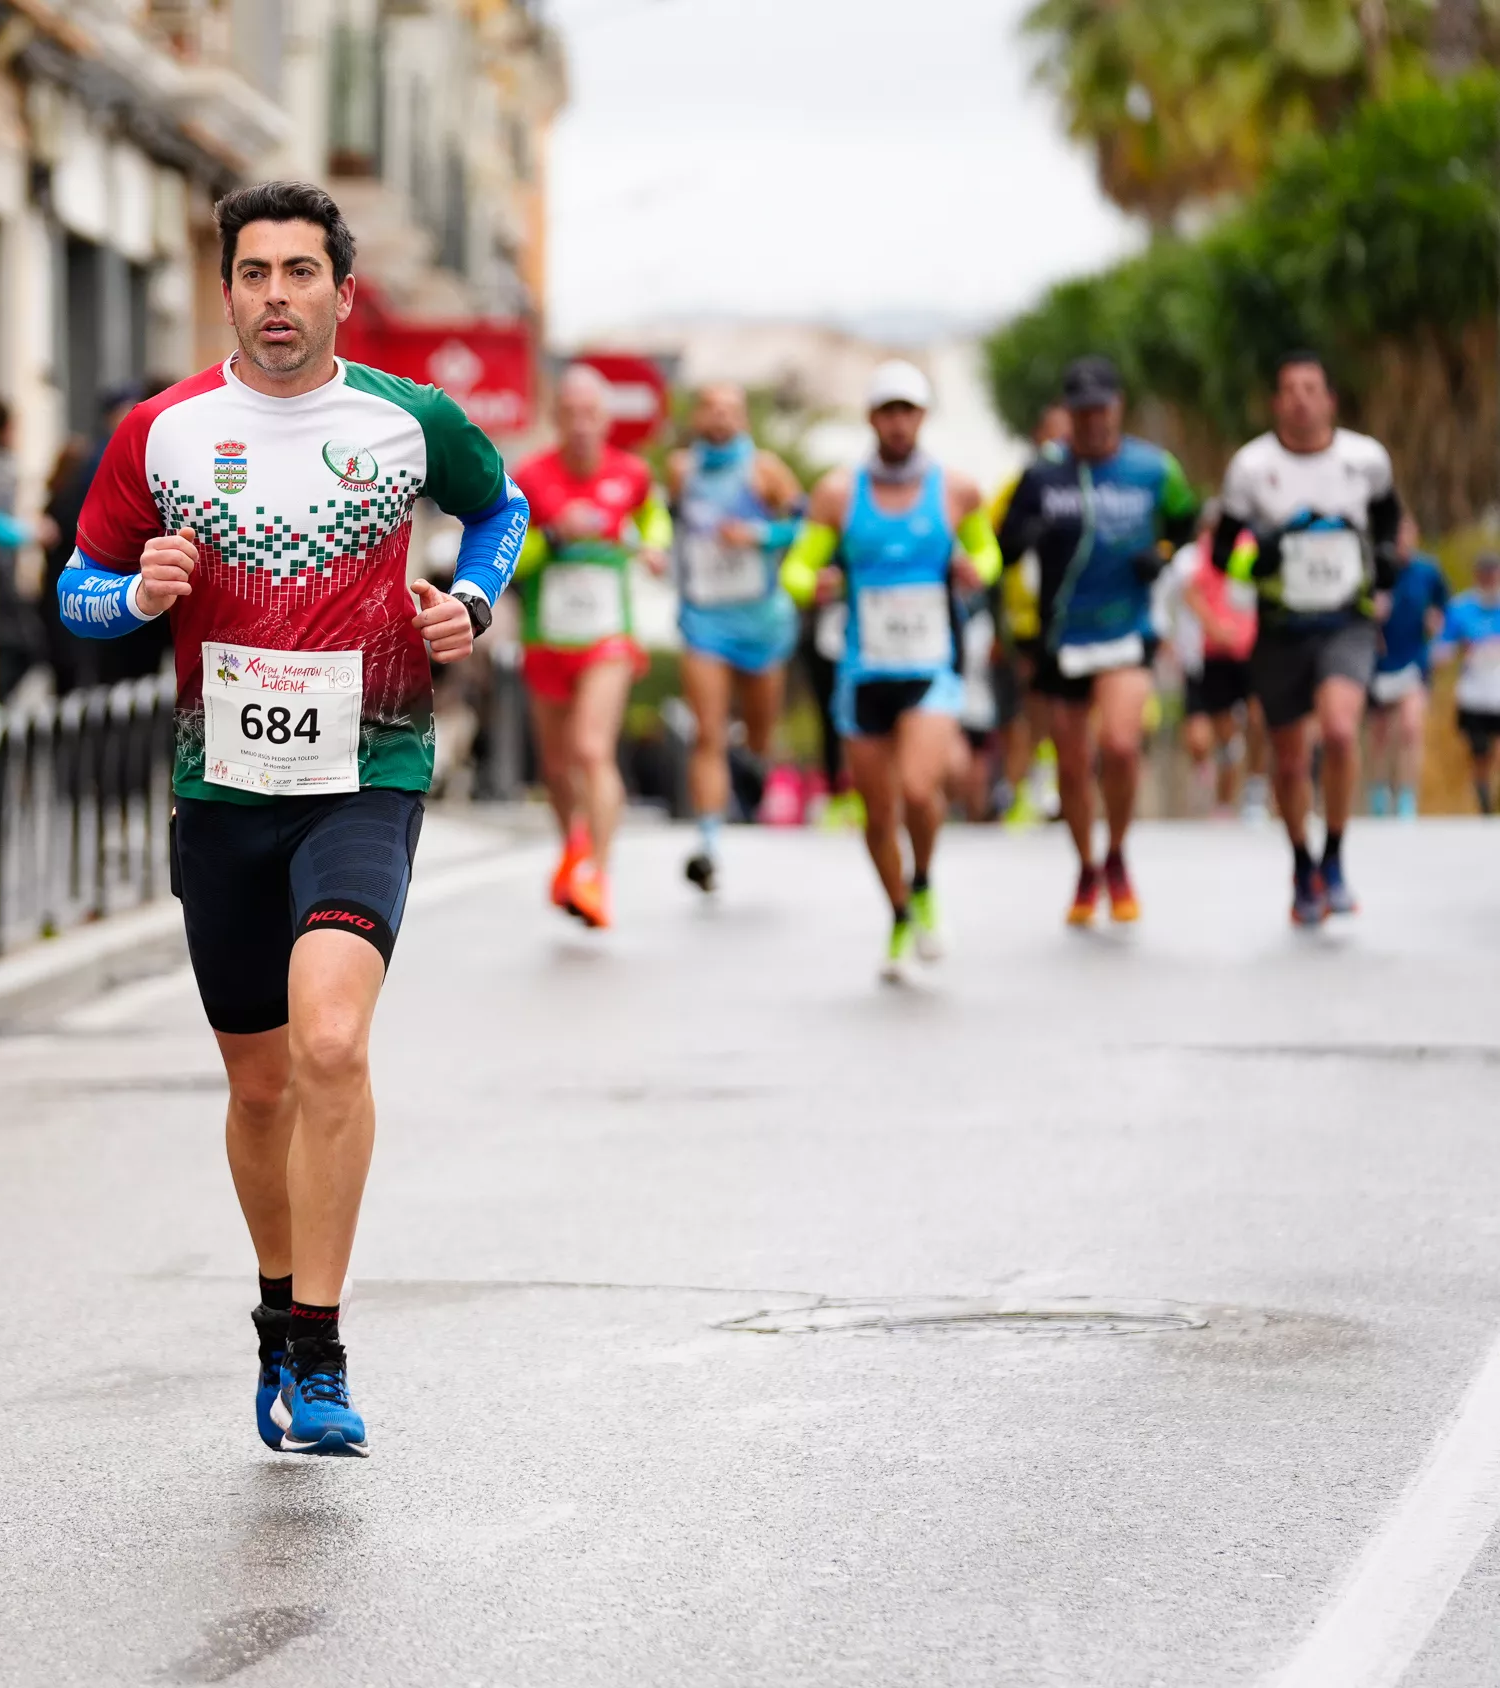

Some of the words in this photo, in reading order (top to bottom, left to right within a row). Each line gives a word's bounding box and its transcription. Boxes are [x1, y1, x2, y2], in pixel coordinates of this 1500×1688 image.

[337, 479, 378, 493] TRABUCO
[493, 511, 527, 576] SKYRACE
[77, 575, 128, 592] SKYRACE
[62, 590, 83, 622] LOS
[84, 590, 122, 628] TAJOS
[261, 674, 310, 694] LUCENA
[240, 703, 321, 745] 684
[263, 762, 292, 770] M-Hombre
[306, 910, 376, 931] HOKO
